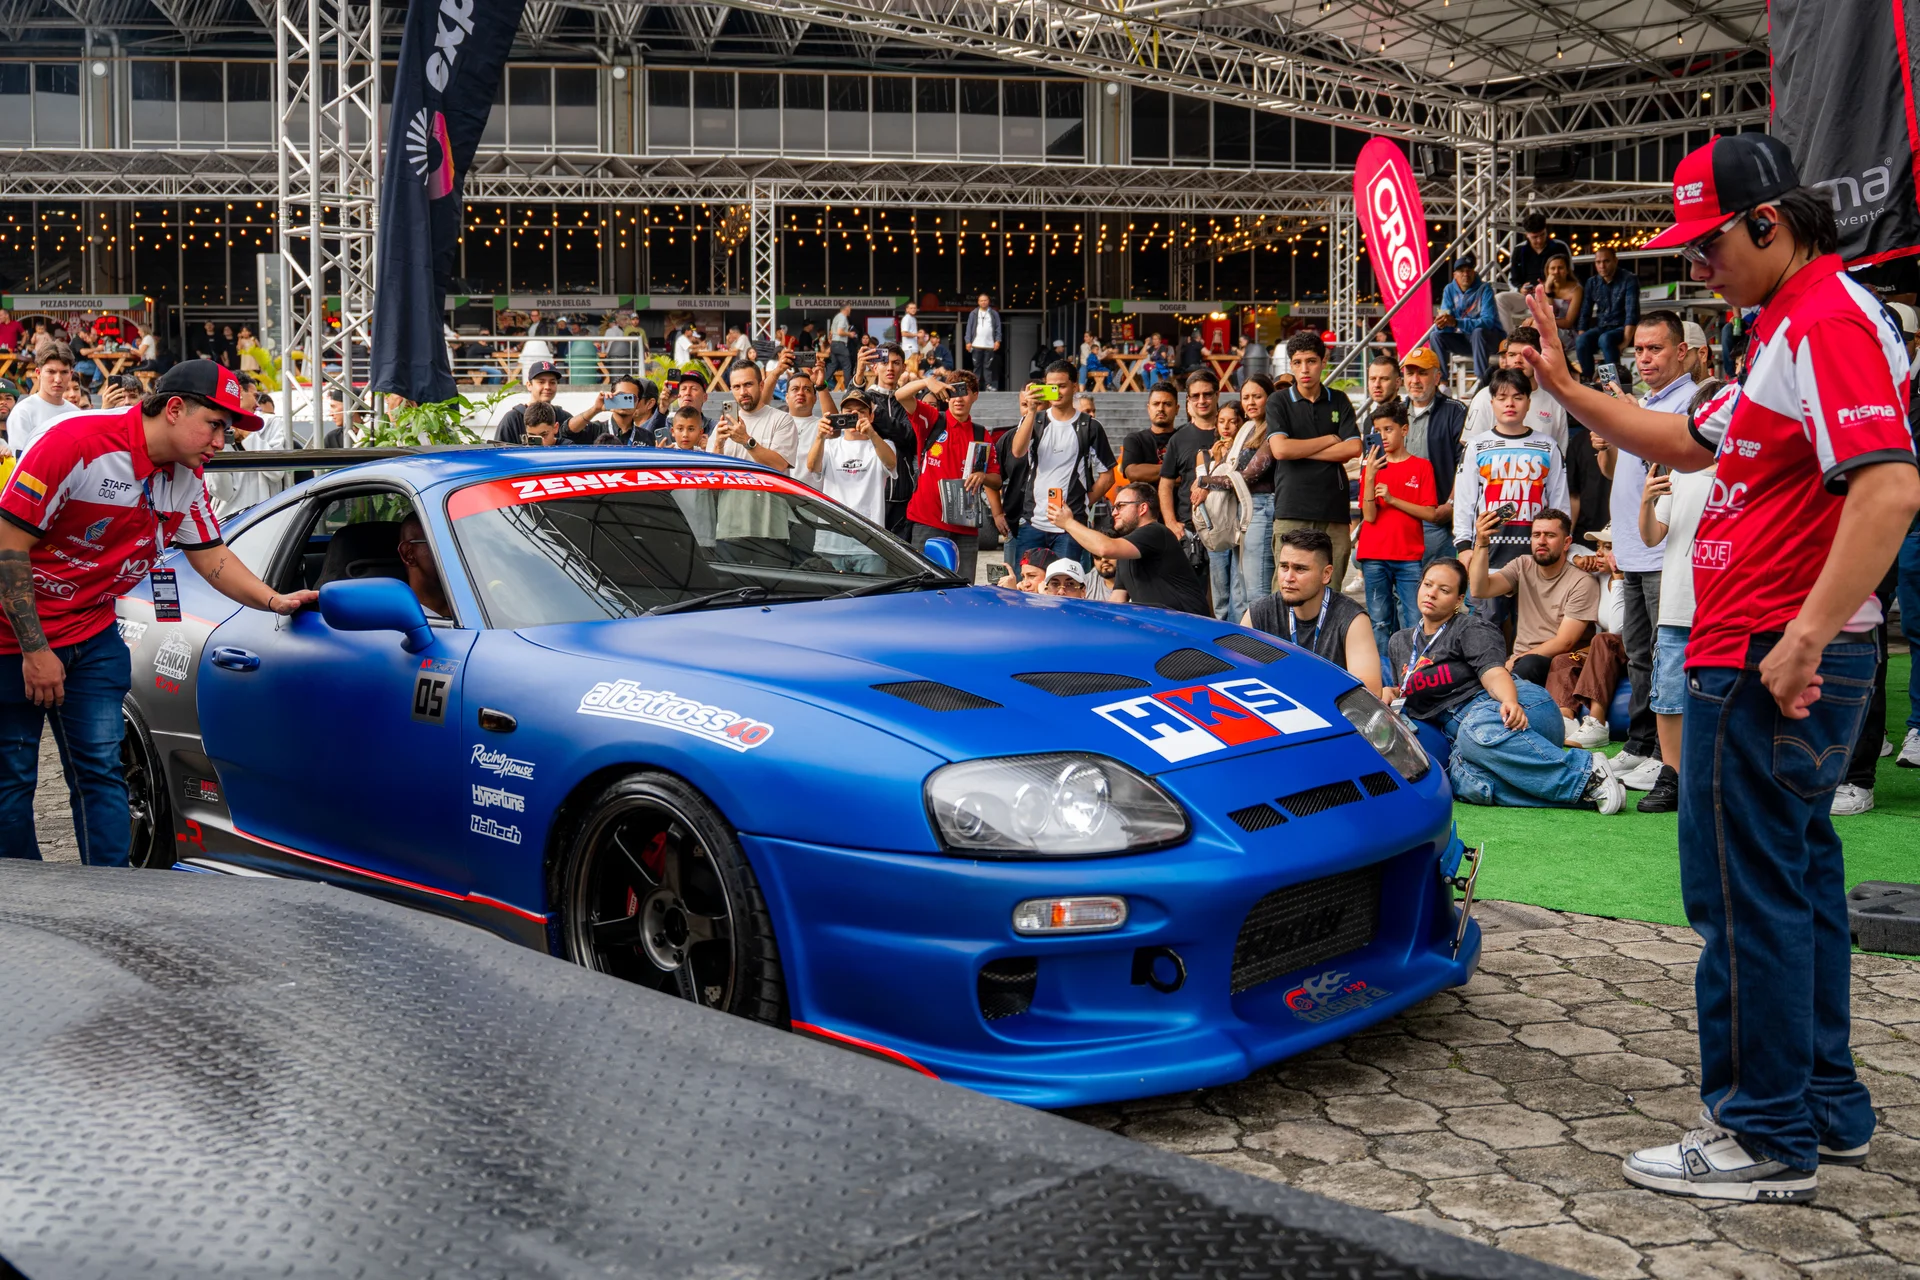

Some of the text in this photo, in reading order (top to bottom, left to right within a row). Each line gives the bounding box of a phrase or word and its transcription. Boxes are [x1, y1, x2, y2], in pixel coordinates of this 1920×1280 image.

[1374, 177, 1418, 290] CRC
[40, 300, 103, 308] PIZZAS PICCOLO
[536, 299, 591, 307] PAPAS BELGAS
[795, 299, 803, 307] EL
[805, 299, 832, 307] PLACER
[1837, 405, 1896, 424] Prisma
[1736, 439, 1762, 451] expo
[1738, 448, 1758, 459] car
[928, 457, 941, 467] IBM
[1490, 454, 1543, 480] KISS
[102, 478, 132, 492] STAFF
[511, 470, 680, 499] ZENKAI
[680, 475, 774, 488] APPAREL
[1500, 480, 1533, 501] MY
[98, 487, 116, 499] 008
[119, 558, 150, 576] MD
[155, 648, 189, 673] ZENKAI
[157, 666, 180, 678] APPAREL
[1413, 663, 1453, 692] Bull
[414, 677, 446, 718] 05
[1102, 681, 1305, 748] HKS
[471, 743, 535, 780] Racing House
[472, 784, 525, 812] Hypertune
[471, 815, 521, 844] Haltech
